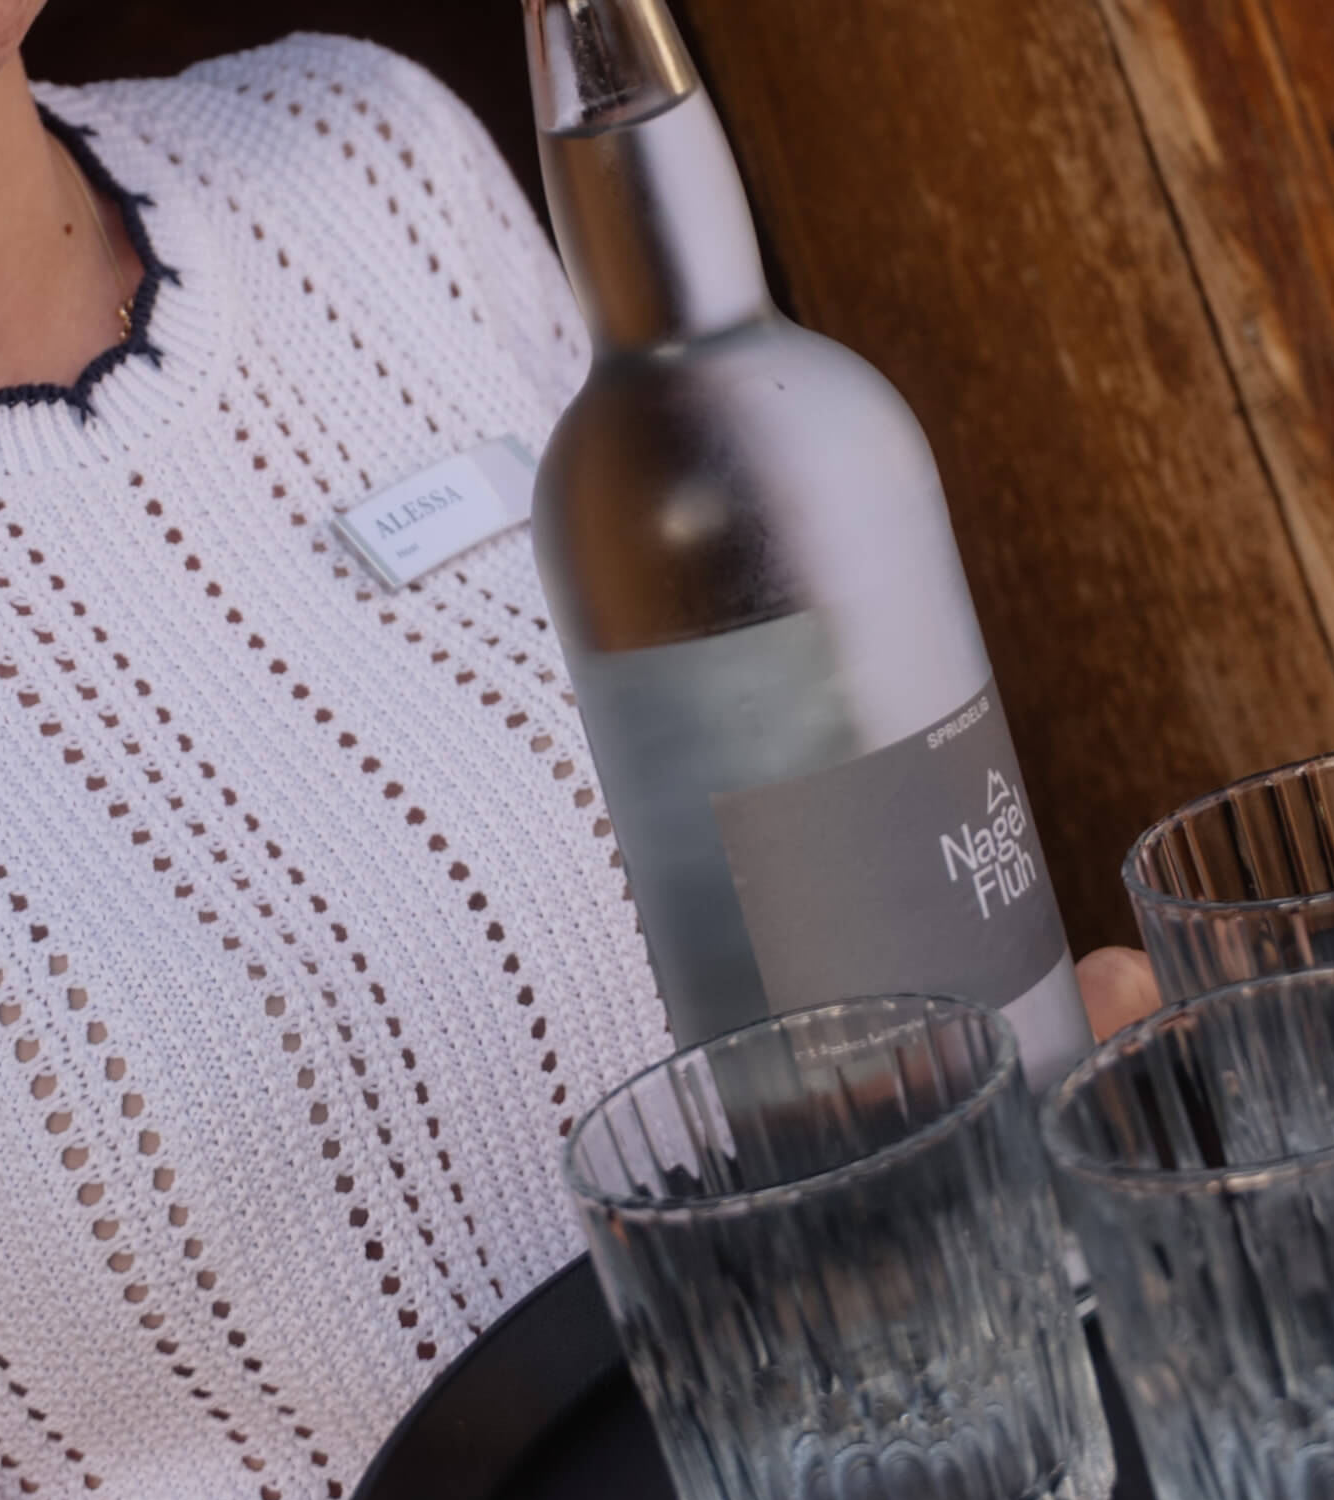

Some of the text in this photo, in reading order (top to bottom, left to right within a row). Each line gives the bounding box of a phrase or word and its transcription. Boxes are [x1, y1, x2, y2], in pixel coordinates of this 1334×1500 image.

[375, 485, 463, 539] ALESSA
[939, 784, 1027, 882] Nagel
[973, 843, 1037, 920] Fluh
